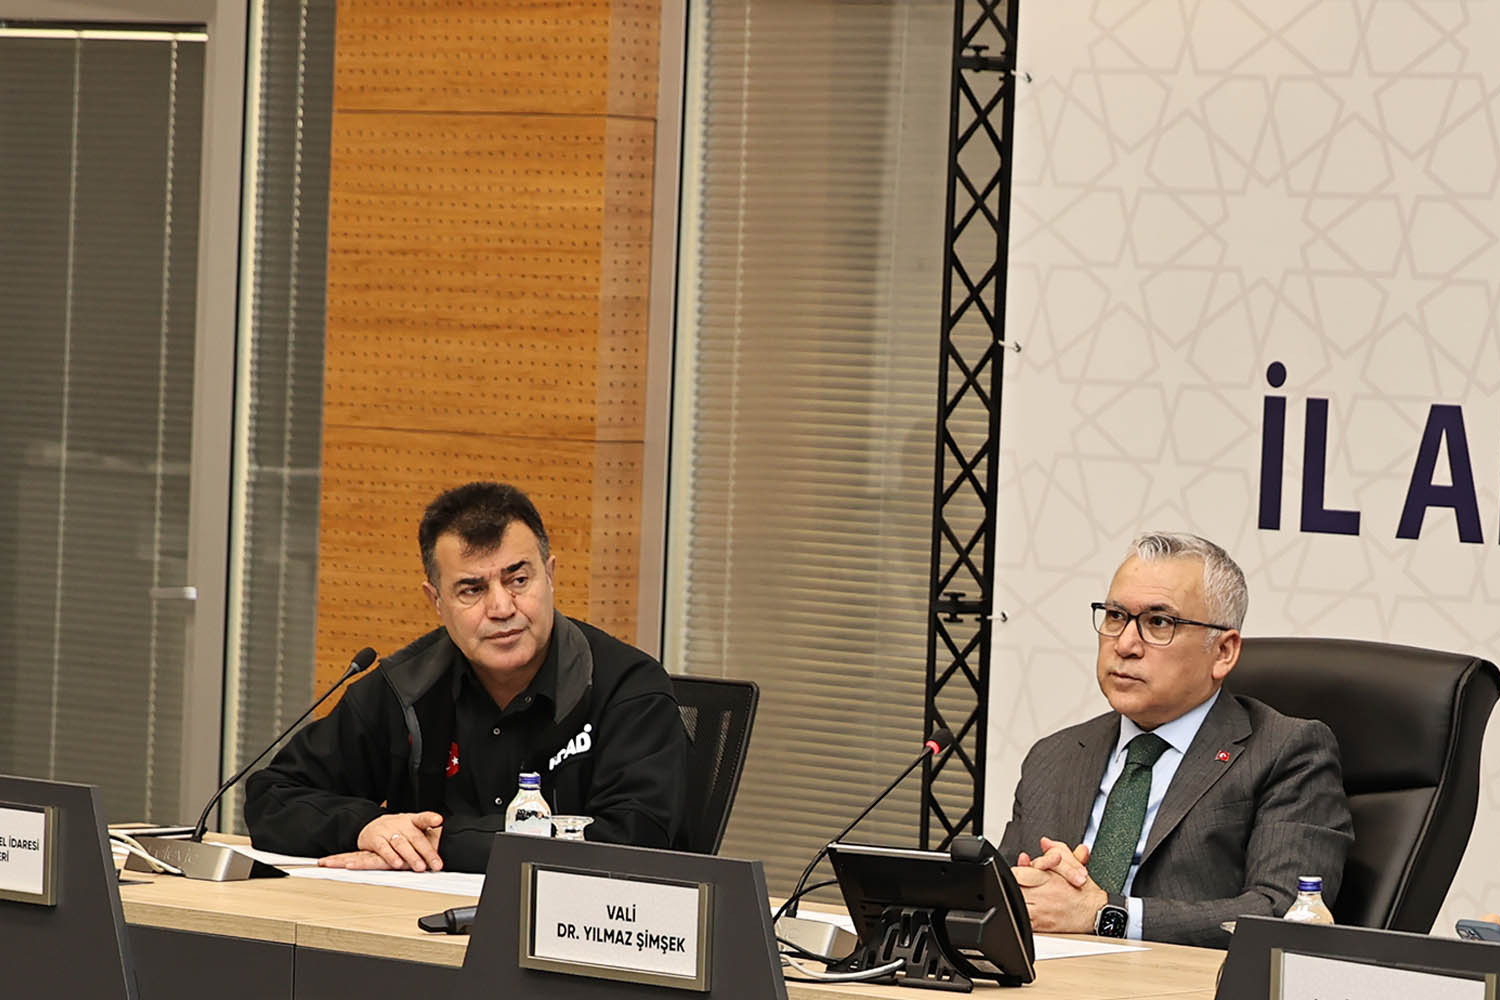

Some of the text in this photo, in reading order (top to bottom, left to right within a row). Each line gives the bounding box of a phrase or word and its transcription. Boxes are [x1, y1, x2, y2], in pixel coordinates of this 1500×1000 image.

[1257, 361, 1361, 537] İL
[8, 834, 40, 851] İDARESİ
[606, 904, 636, 923] VALİ
[557, 923, 686, 954] DR. YILMAZ ŞİMŞEK
